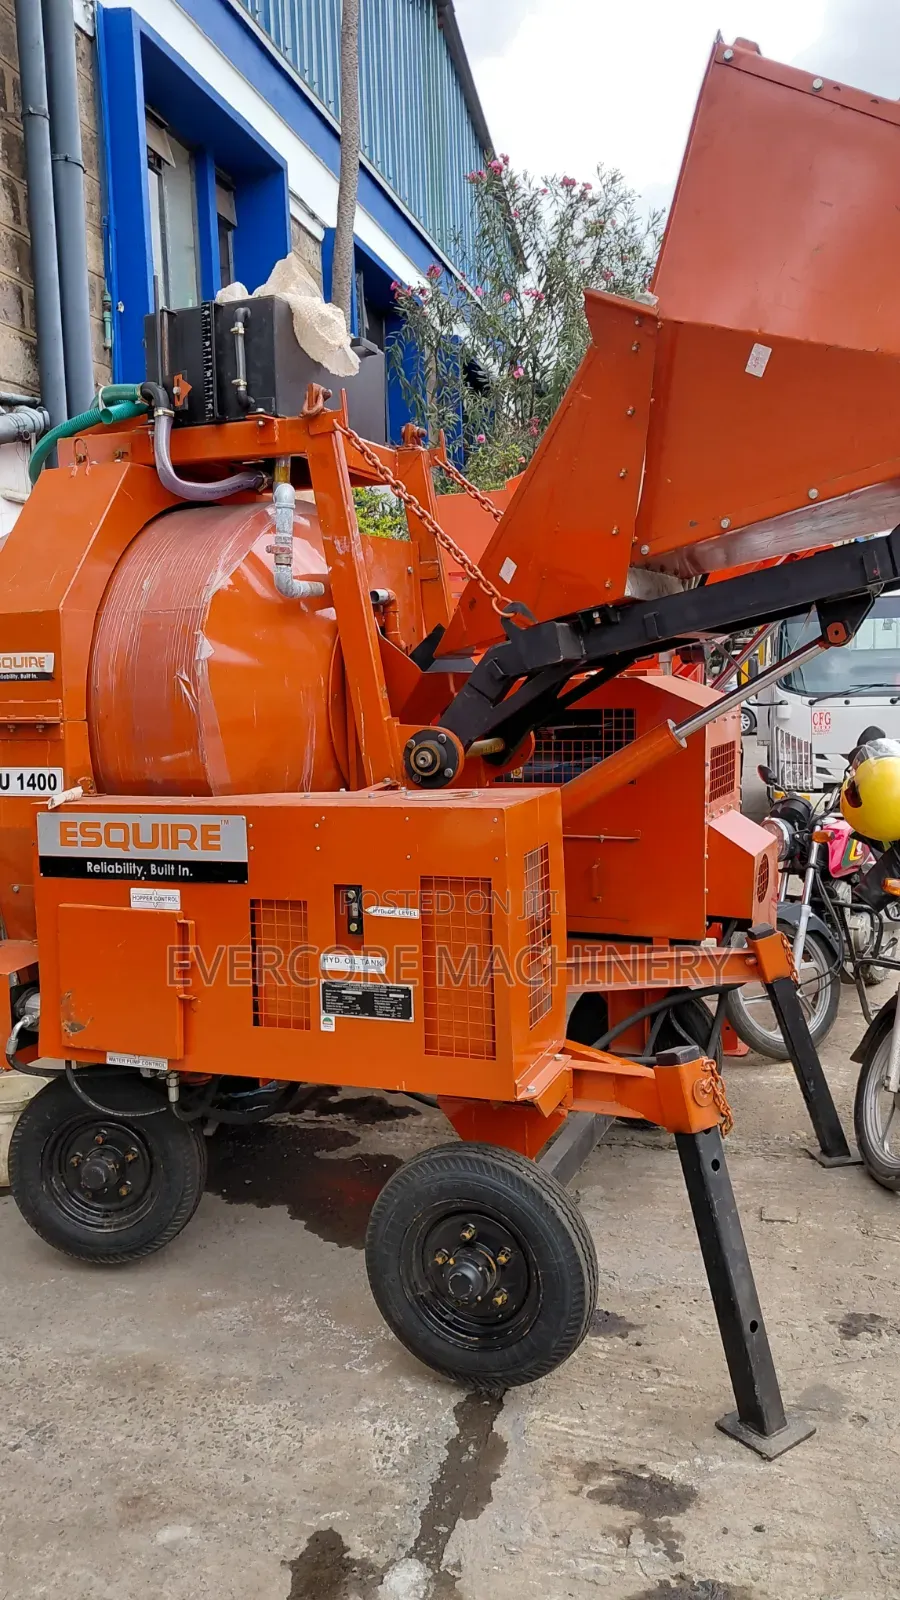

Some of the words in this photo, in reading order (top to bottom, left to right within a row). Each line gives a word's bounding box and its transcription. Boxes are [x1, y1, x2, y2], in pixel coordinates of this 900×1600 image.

[0, 656, 45, 669] QUIRE
[812, 712, 831, 726] CFG
[16, 773, 57, 791] 1400
[59, 821, 221, 851] ESQUIRE
[86, 861, 147, 876] Reliability.
[150, 864, 175, 876] Built
[178, 866, 193, 876] In.
[360, 958, 384, 966] TANK
